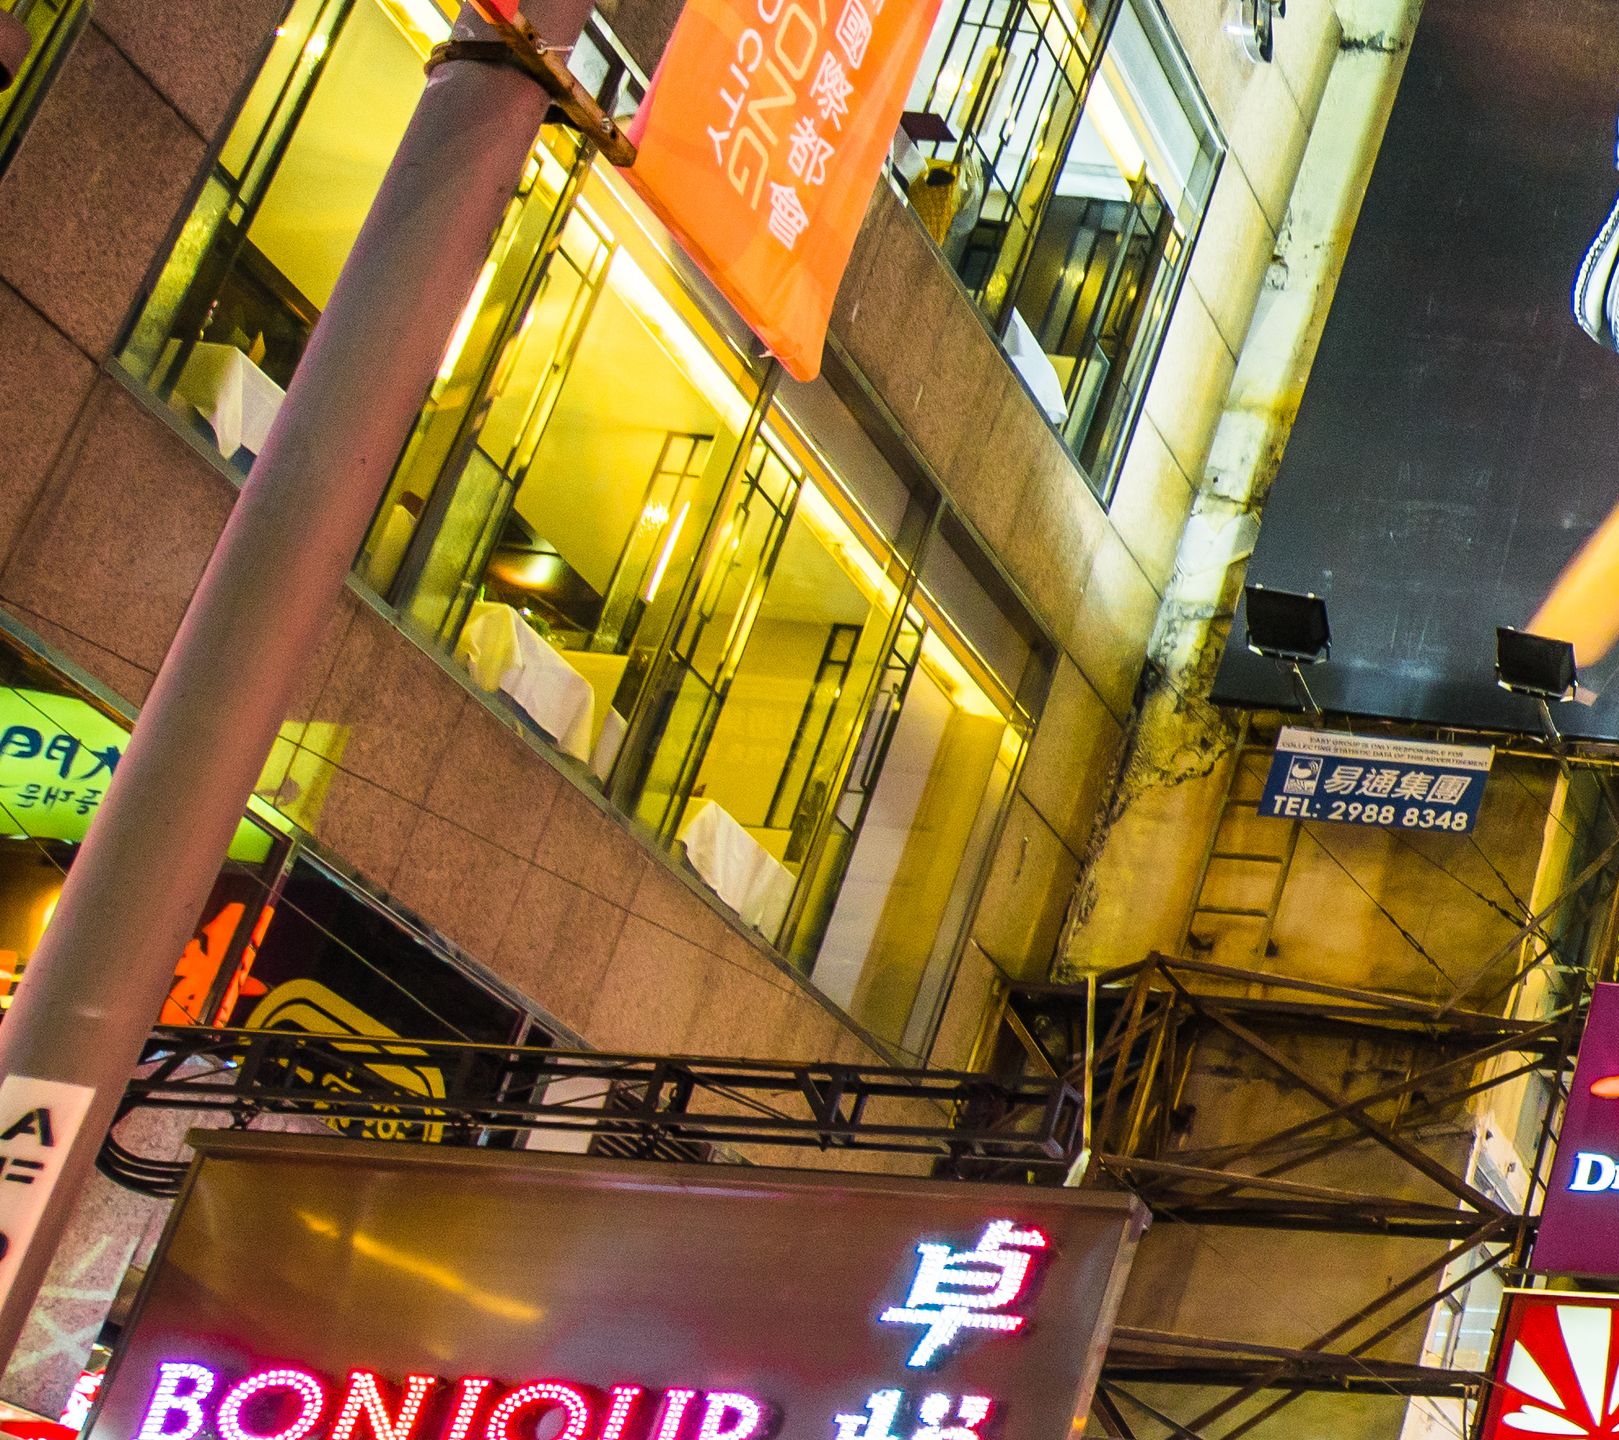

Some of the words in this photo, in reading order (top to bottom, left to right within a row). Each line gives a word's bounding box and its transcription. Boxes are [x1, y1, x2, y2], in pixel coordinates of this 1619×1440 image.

[1324, 766, 1472, 806] 易通集團
[1327, 801, 1396, 825] 2988
[1401, 808, 1469, 832] 8348
